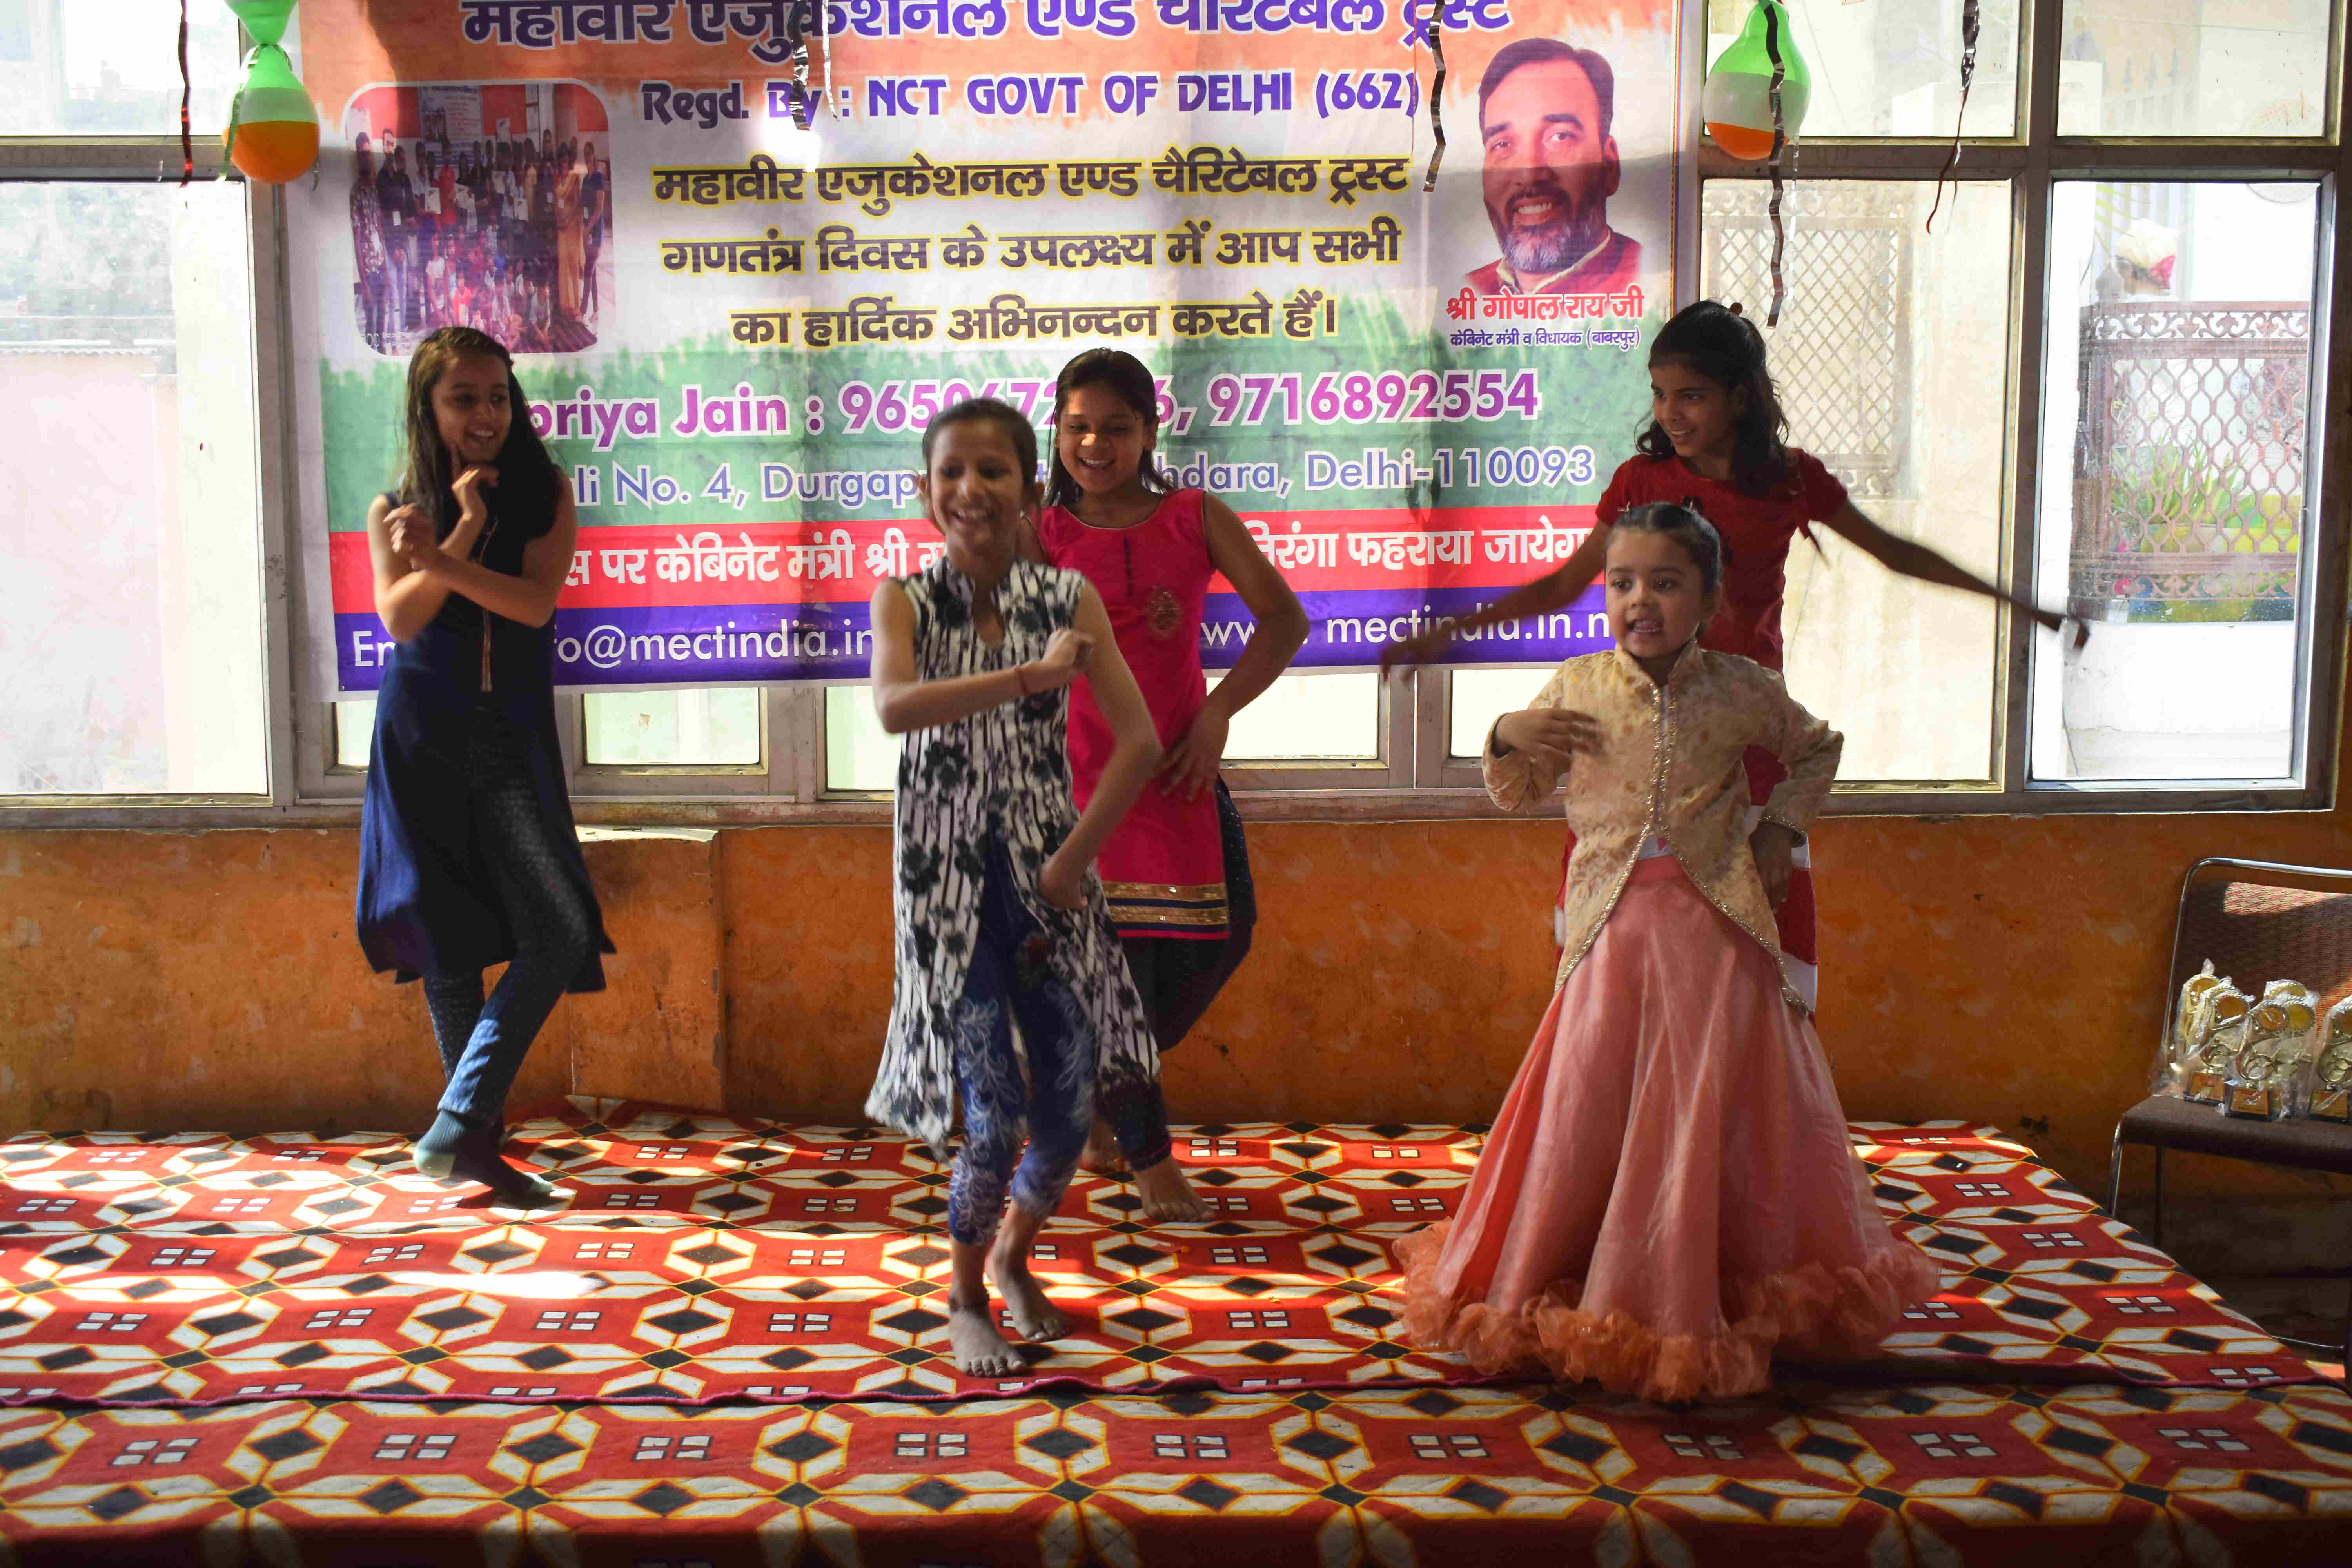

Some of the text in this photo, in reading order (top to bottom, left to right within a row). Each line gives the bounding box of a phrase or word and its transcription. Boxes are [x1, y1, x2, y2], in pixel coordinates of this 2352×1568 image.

[688, 0, 1006, 64] एजुकशनल
[1027, 0, 1136, 37] एण्ड
[642, 82, 749, 129] Regd.
[869, 80, 947, 116] NCT
[967, 77, 1083, 115] GOVT
[1104, 75, 1158, 116] OF
[1177, 72, 1293, 116] DELHI
[1315, 72, 1419, 118] (662)
[653, 146, 1411, 216] महावीर एजुकेशनल एण्ड चैरिटेबल ट्रस्ट
[661, 215, 1402, 273] गणतंत्र दिवस के उपलक्ष्य में आप सभी
[730, 313, 792, 344] का
[801, 296, 937, 347] हार्दिक
[947, 294, 1161, 340] अभिनन्दन
[1171, 290, 1274, 336] करते
[1445, 285, 1645, 321] श्री गोपाल राय जी
[1495, 328, 1520, 346] मंत्री
[1523, 332, 1532, 346] व
[1535, 328, 1582, 346] विधायक
[526, 388, 657, 447] priya
[675, 386, 787, 434] Jain
[1210, 372, 1539, 422] 9716892554
[616, 467, 689, 506] No.
[706, 466, 746, 507] 4,
[764, 465, 919, 506] Durgap
[1308, 448, 1593, 488] Delhi-110093
[599, 549, 649, 585] पर
[654, 531, 780, 583] केबिनेट
[786, 528, 856, 580] मंत्री
[864, 527, 910, 579] श्री
[1347, 530, 1475, 570] फहराया
[554, 618, 875, 668] o@mectindia.in
